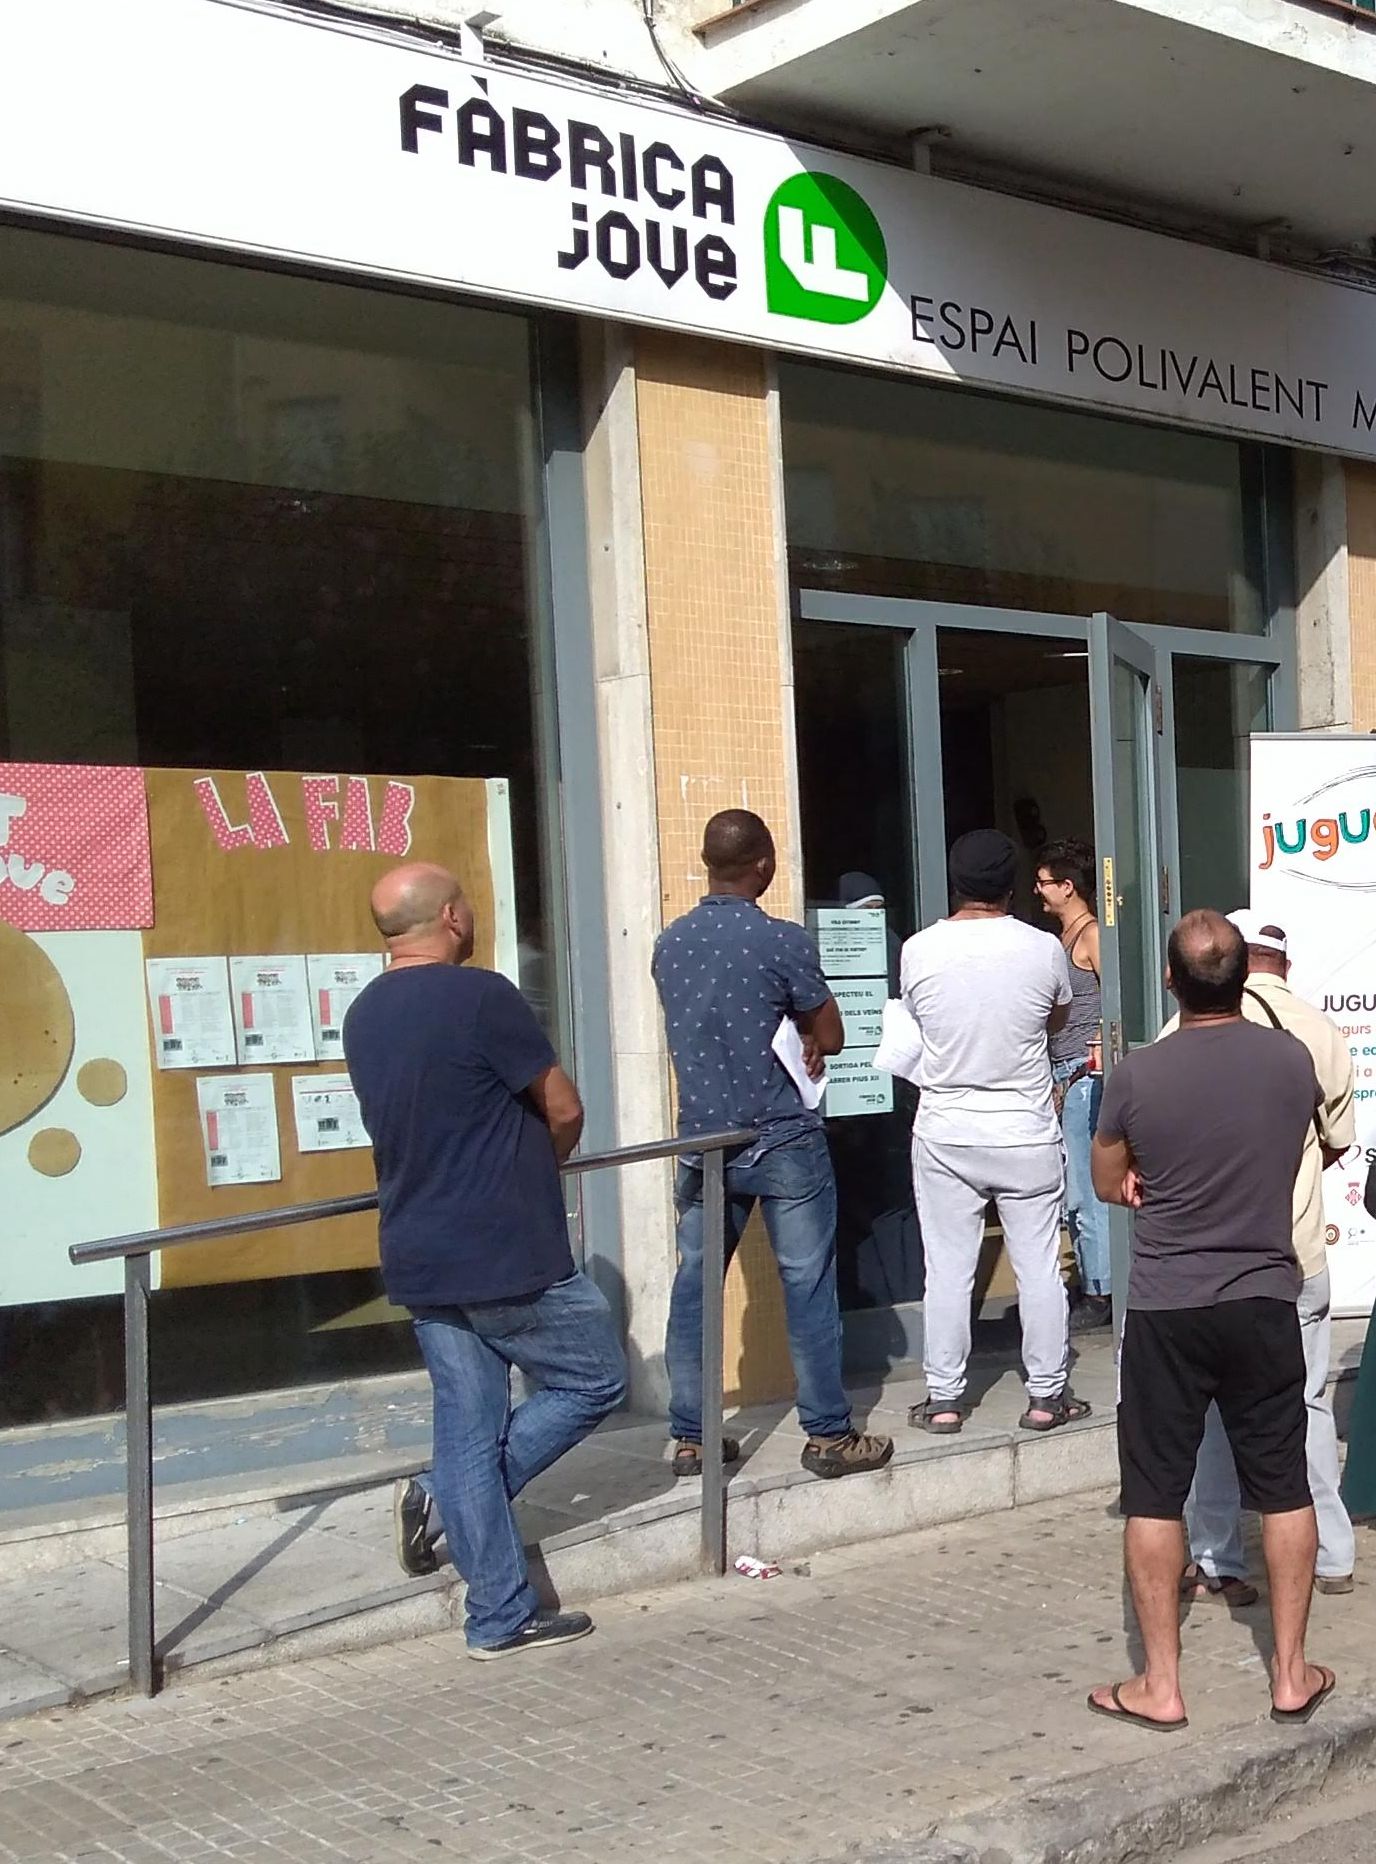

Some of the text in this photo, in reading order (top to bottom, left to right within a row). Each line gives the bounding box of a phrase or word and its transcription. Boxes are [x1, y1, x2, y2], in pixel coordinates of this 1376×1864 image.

[399, 75, 736, 225] FÀBRICA
[910, 295, 1037, 365] ESPAI
[1066, 329, 1329, 423] POLIVALENT
[302, 775, 415, 857] FAB
[1338, 1024, 1371, 1038] gurs
[1363, 1067, 1373, 1077] a
